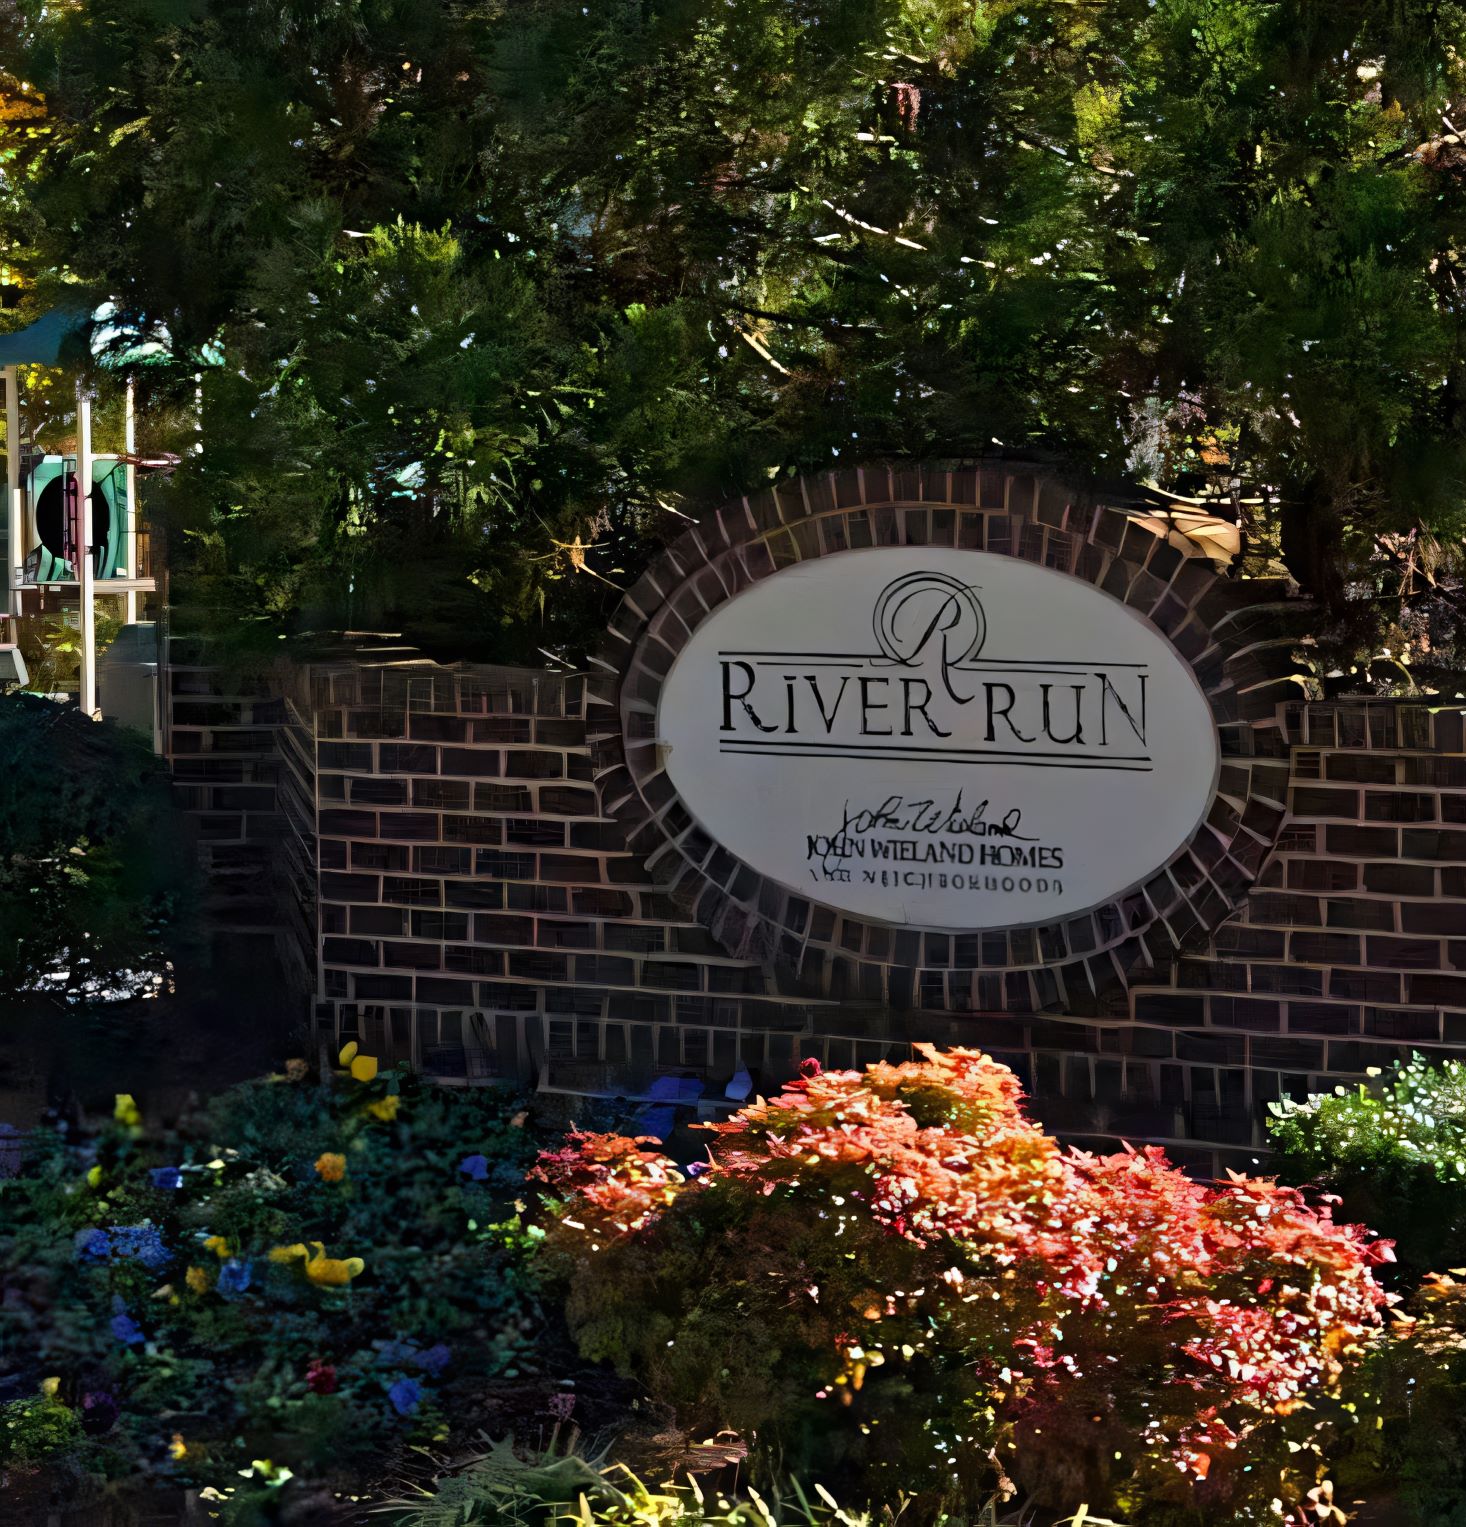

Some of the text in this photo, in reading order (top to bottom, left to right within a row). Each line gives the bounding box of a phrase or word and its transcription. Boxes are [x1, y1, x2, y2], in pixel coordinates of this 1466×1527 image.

[719, 661, 1150, 748] RIVER RUN
[870, 839, 978, 865] WIELAND
[980, 844, 1064, 869] HOMES
